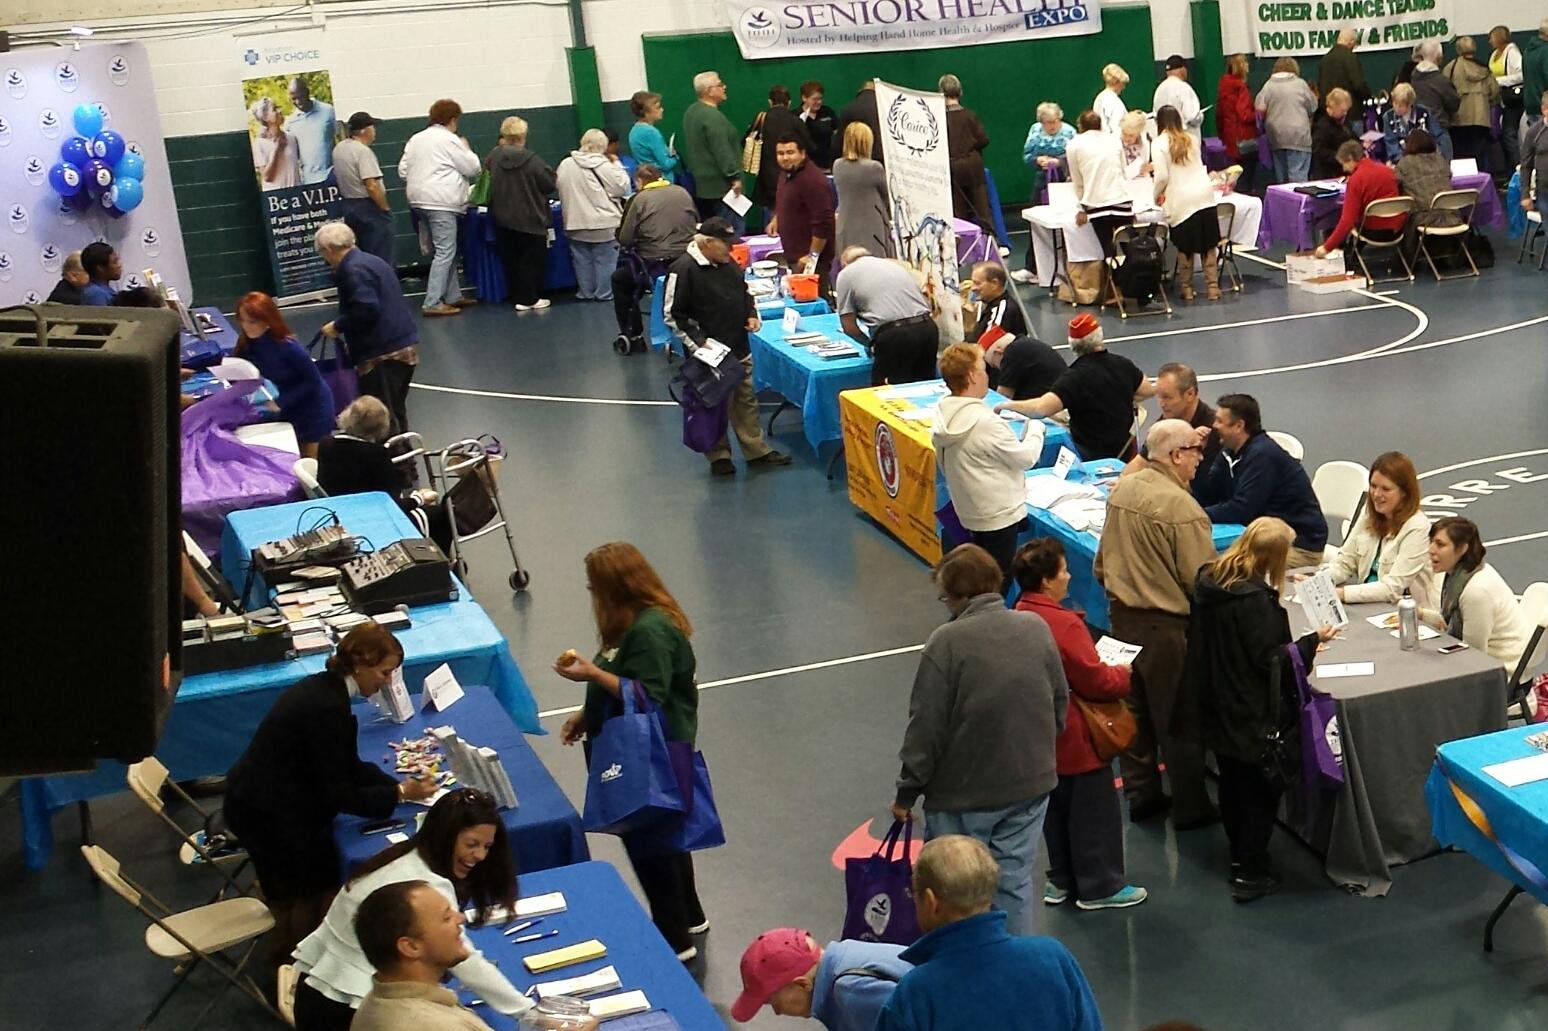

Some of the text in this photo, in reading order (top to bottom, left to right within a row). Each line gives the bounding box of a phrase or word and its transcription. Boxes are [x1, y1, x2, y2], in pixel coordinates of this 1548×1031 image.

[783, 0, 930, 30] SENIOR
[1027, 6, 1086, 29] EXPO
[1258, 3, 1312, 22] CHEER
[1316, 2, 1328, 20] &
[1332, 0, 1385, 19] DANCE
[787, 35, 822, 45] Hosted
[824, 33, 836, 45] by
[839, 33, 878, 43] Helping
[881, 29, 906, 40] Hand
[908, 29, 936, 38] Home
[939, 24, 970, 36] Health
[1309, 28, 1365, 49] FAMY
[1368, 27, 1381, 44] &
[1384, 18, 1449, 43] FRIENDS
[283, 49, 319, 62] CHOICE
[268, 186, 343, 212] Be a V.I.P.
[278, 215, 292, 225] you
[292, 212, 310, 221] have
[310, 208, 328, 219] both
[272, 223, 305, 236] Medicare
[290, 236, 303, 245] the
[276, 249, 299, 259] treats
